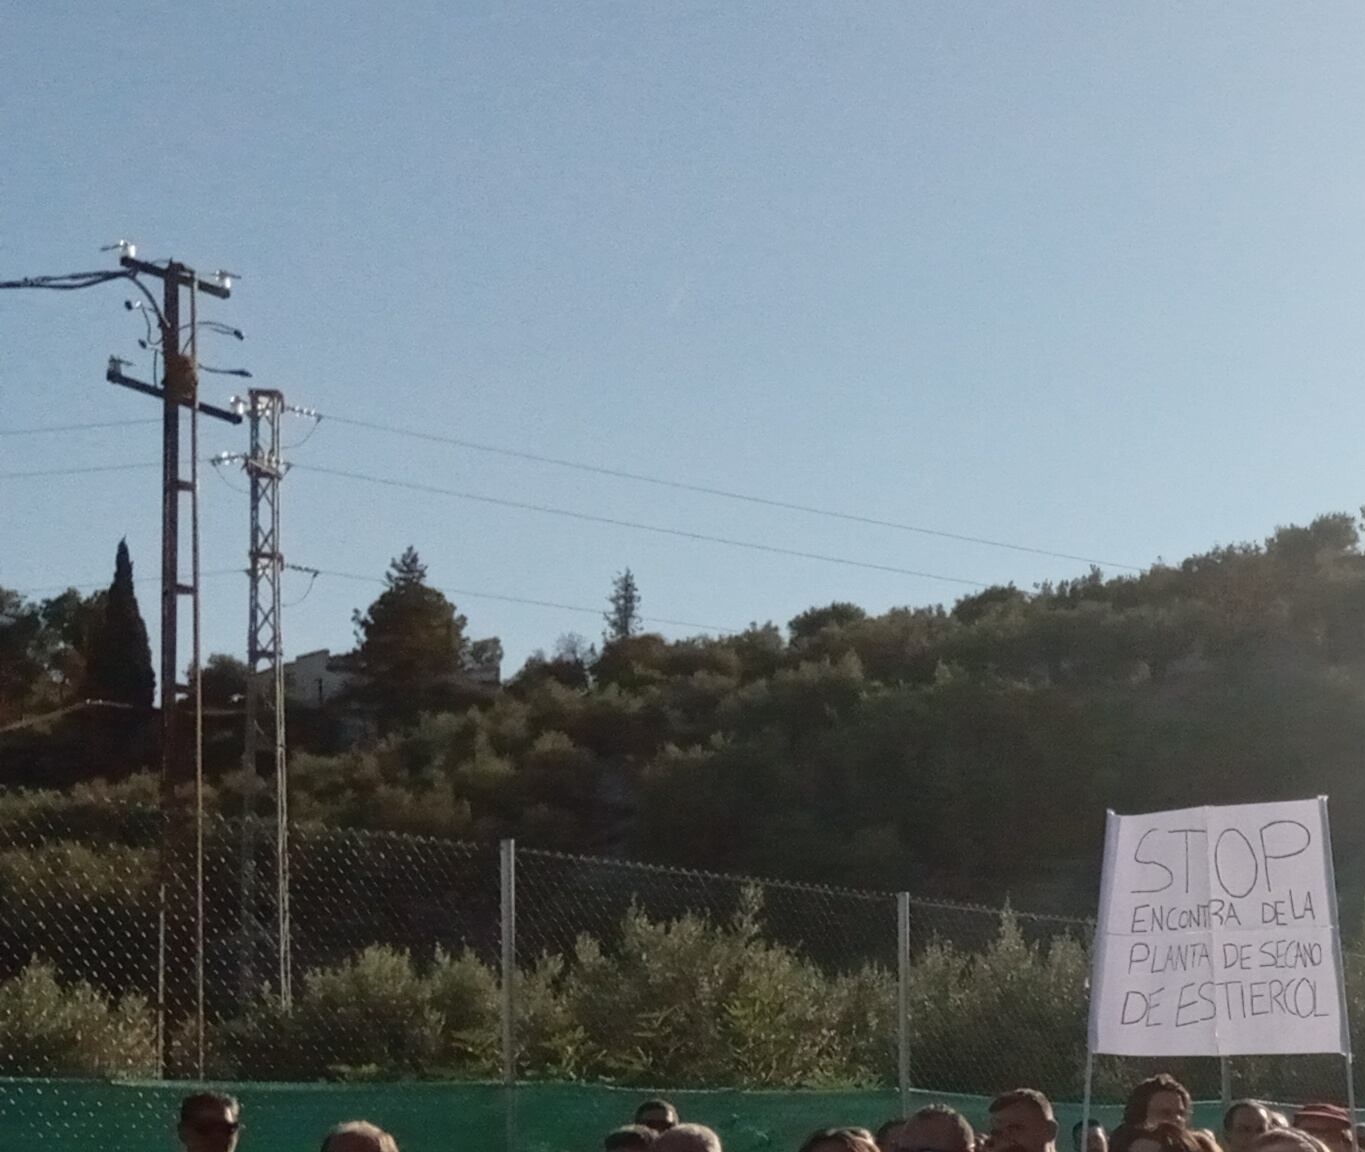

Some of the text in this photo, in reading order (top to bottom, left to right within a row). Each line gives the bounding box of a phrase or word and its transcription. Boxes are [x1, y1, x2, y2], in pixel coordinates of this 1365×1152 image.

[1131, 820, 1311, 898] STOP
[1128, 942, 1214, 974] PLANTA
[1223, 943, 1253, 970] DE
[1121, 977, 1329, 1027] DE ESTIERCOL
